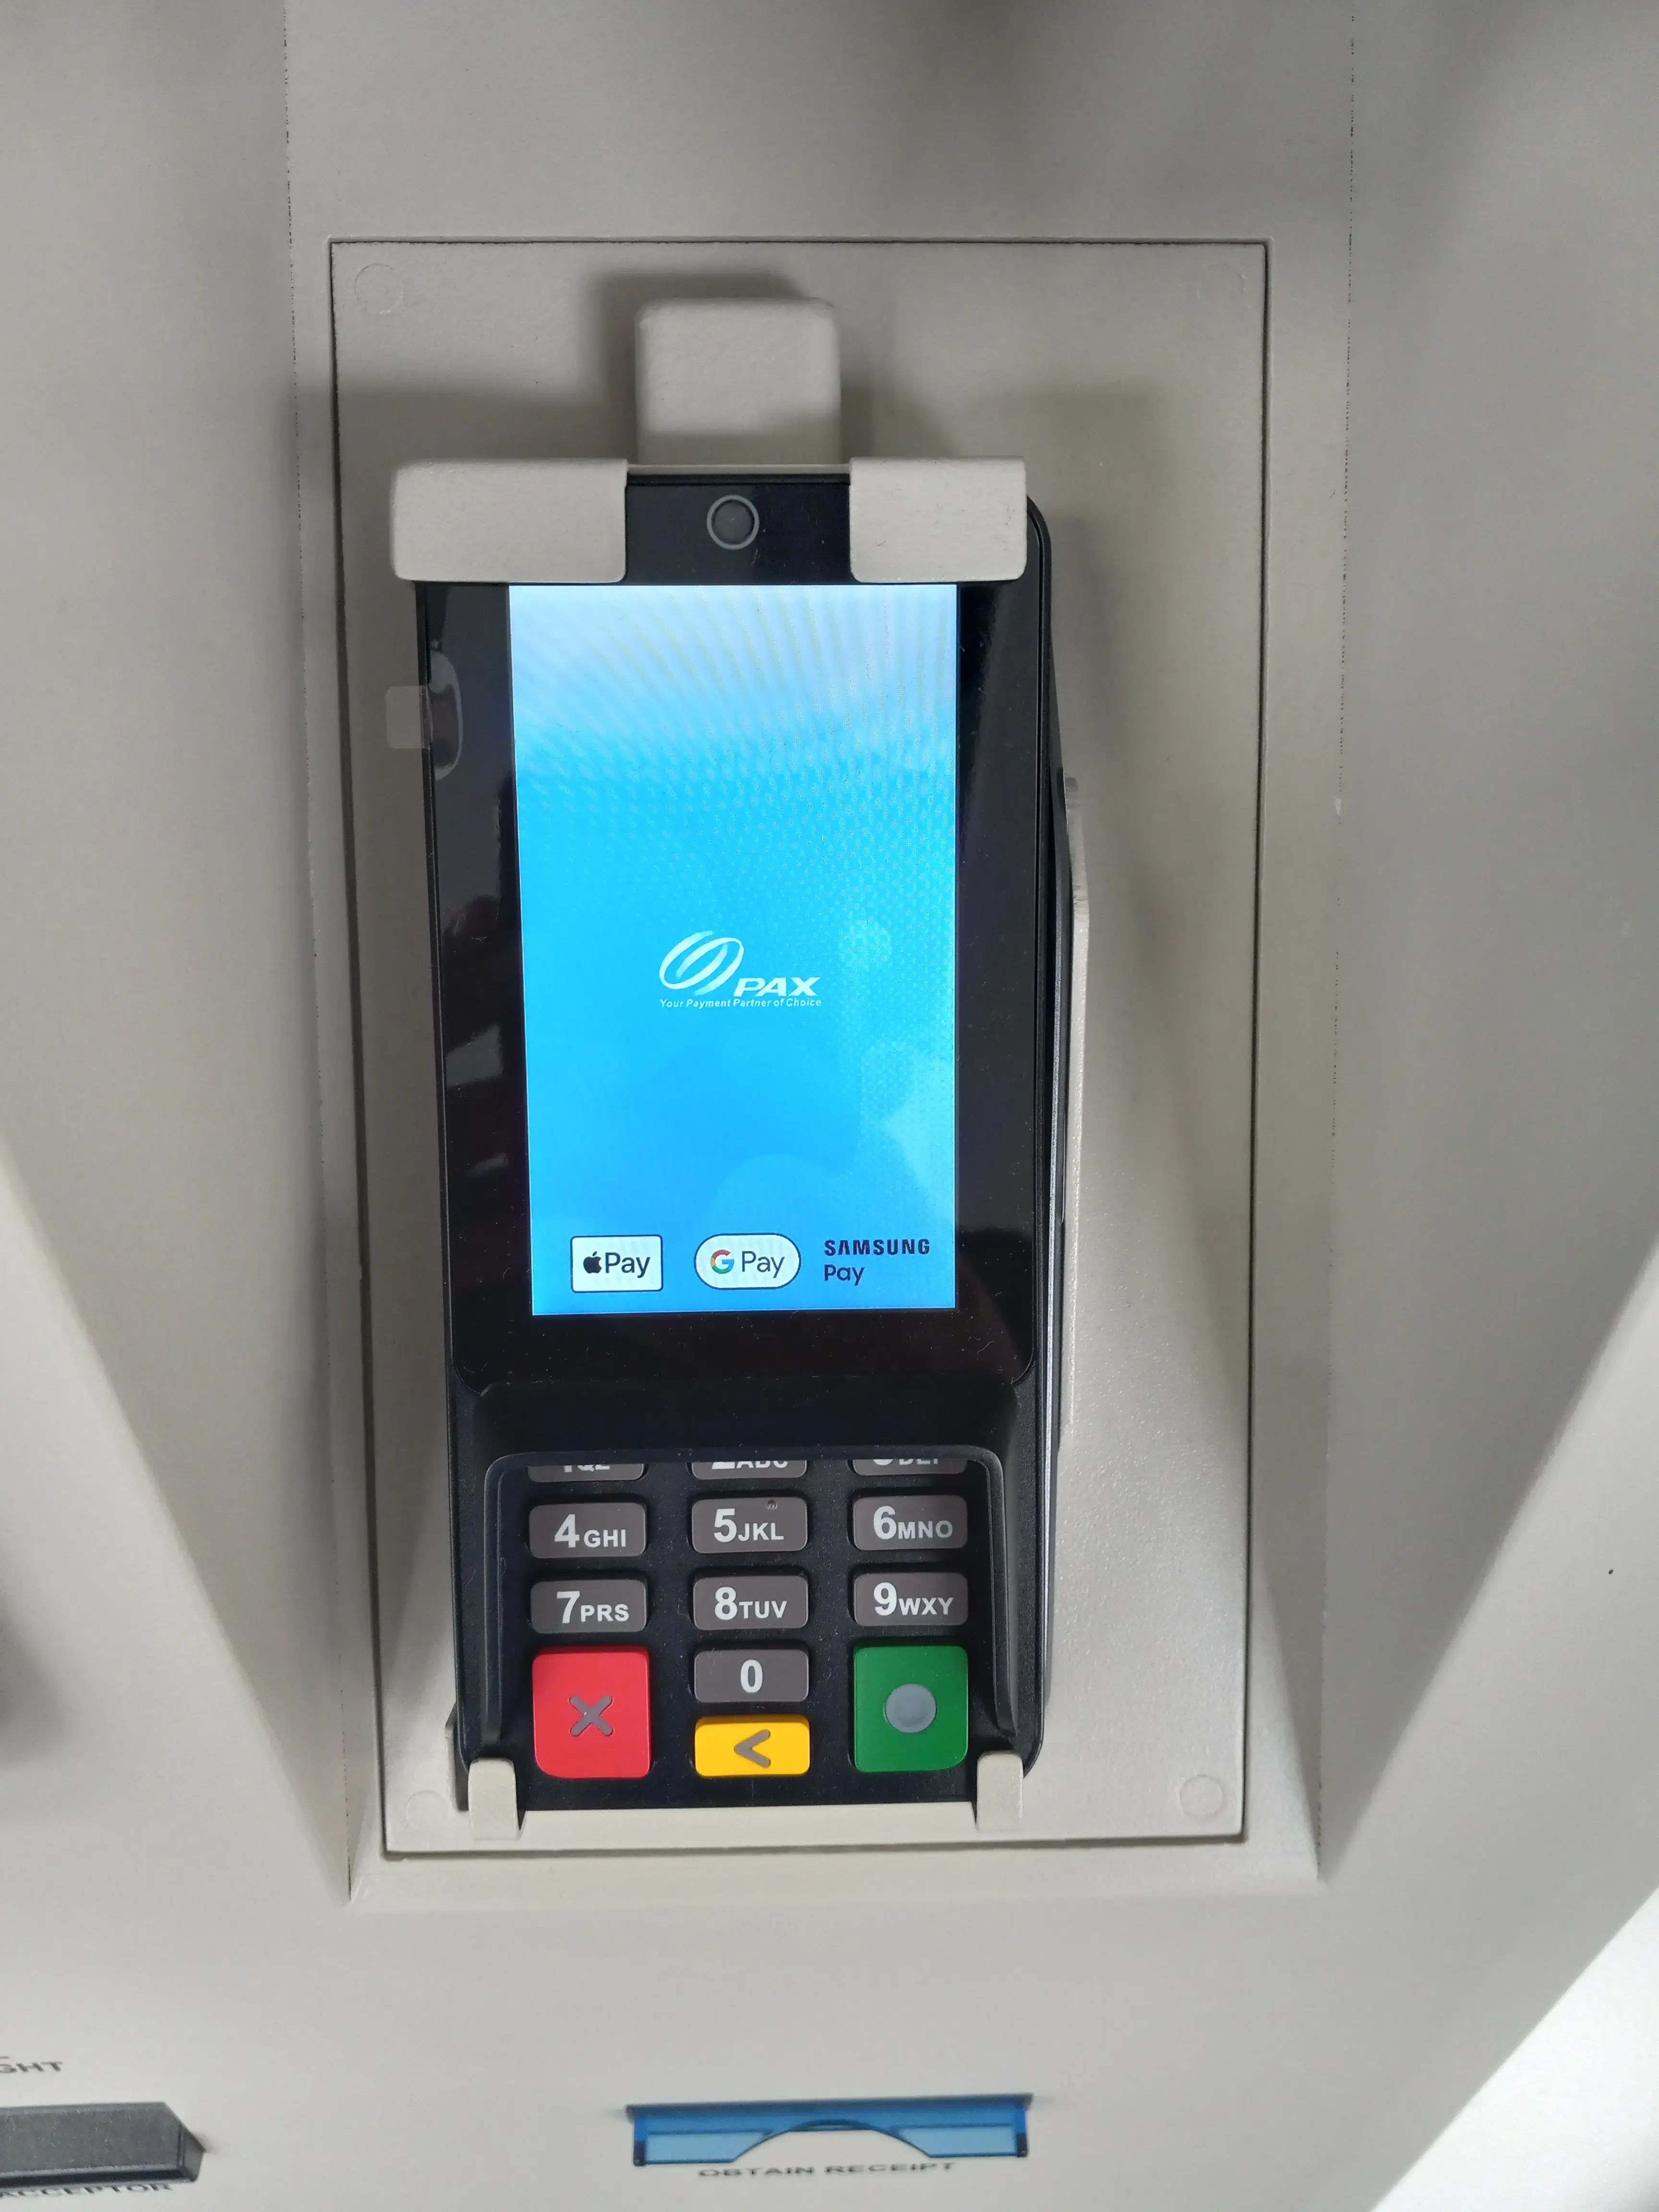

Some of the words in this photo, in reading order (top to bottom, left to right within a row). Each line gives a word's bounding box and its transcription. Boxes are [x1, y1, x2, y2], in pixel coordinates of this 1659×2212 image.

[733, 977, 820, 997] PAX
[660, 998, 683, 1008] Your
[686, 998, 731, 1009] Payment
[733, 998, 770, 1007] Partner
[773, 998, 784, 1007] of
[786, 997, 822, 1007] Choice
[824, 1238, 930, 1256] SAMSUNG
[605, 1251, 651, 1279] Pay
[741, 1250, 785, 1278] Pay
[824, 1263, 865, 1286] Pay
[740, 1659, 763, 1694] 0
[697, 2166, 815, 2177] OBTAIN
[823, 2162, 956, 2174] RECEIPT
